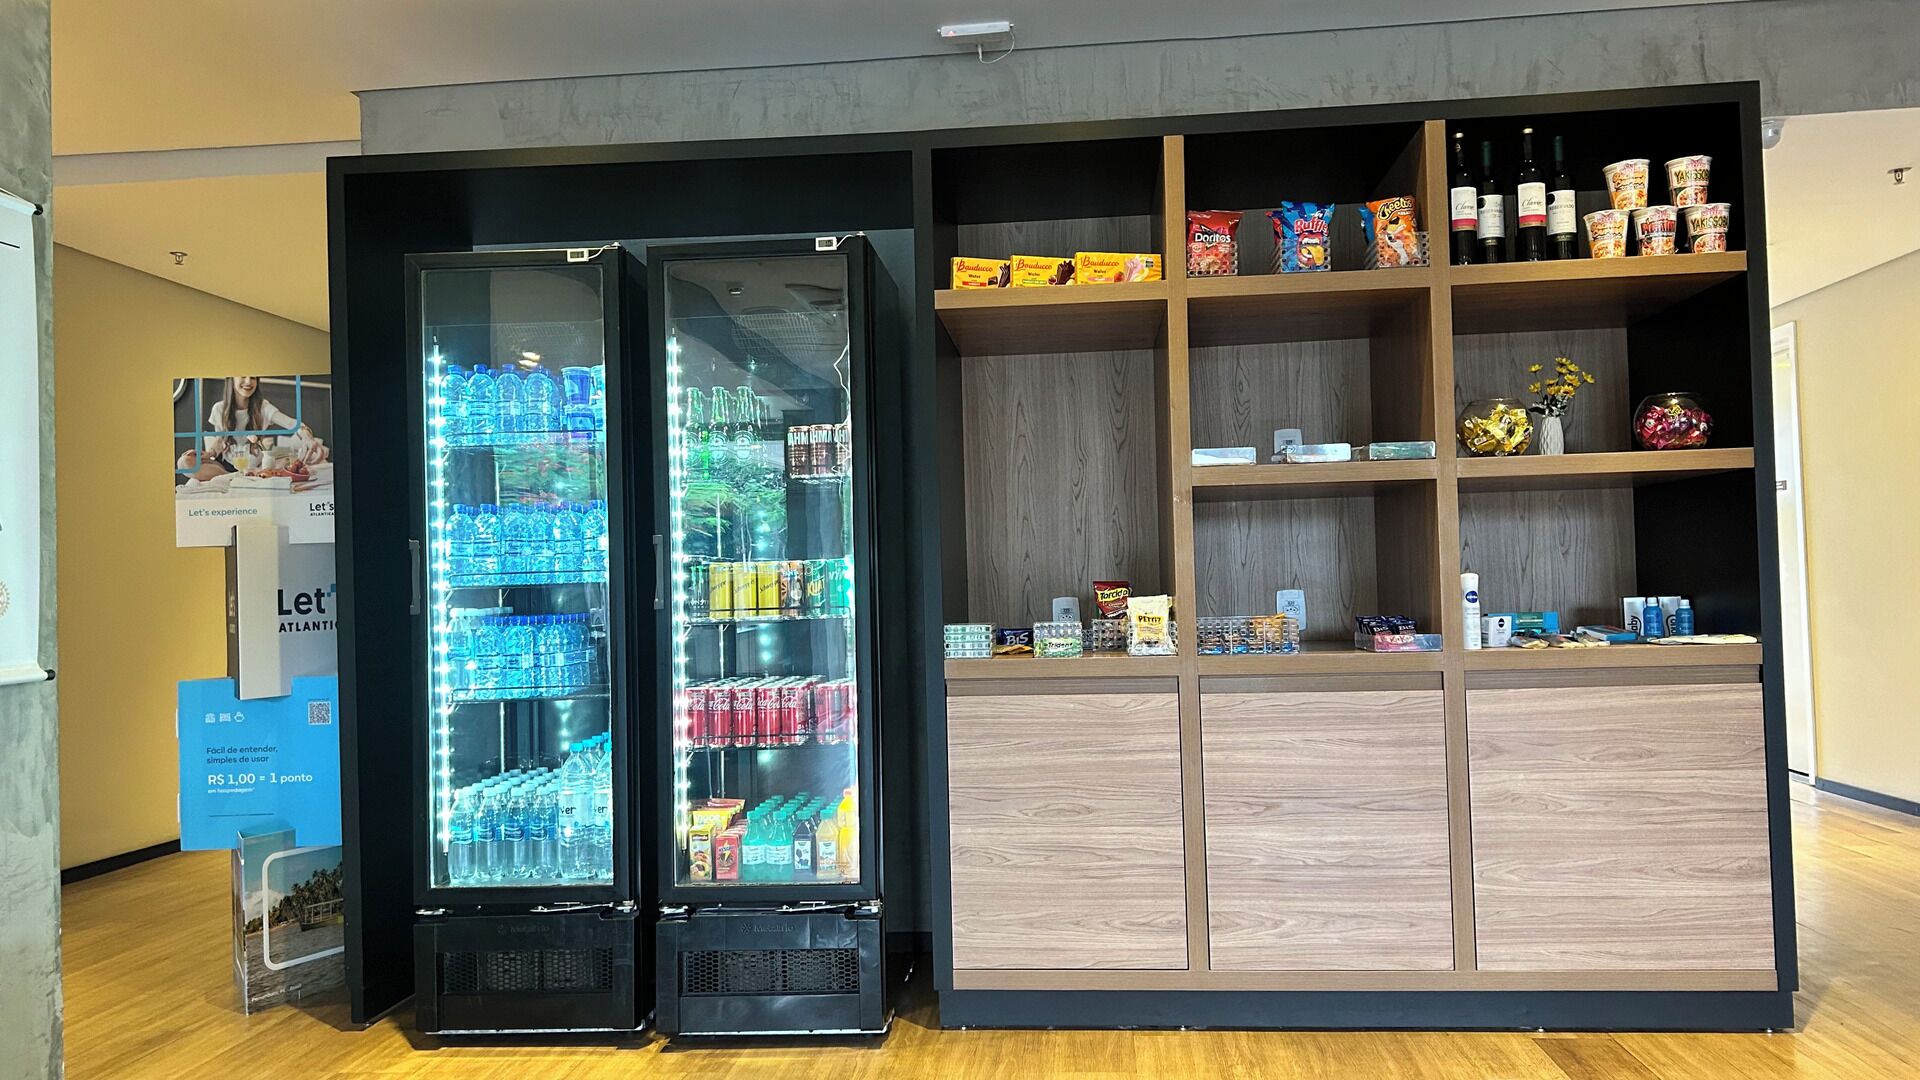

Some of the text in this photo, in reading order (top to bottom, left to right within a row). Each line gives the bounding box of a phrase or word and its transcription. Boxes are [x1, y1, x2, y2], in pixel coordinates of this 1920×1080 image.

[1379, 198, 1413, 220] Cheetos
[1195, 232, 1231, 243] Doritos
[957, 260, 993, 272] Bauducco
[1016, 259, 1053, 271] Bauducco
[1081, 256, 1120, 268] Bauducco
[310, 501, 334, 511] Let's
[188, 507, 258, 517] Let's experience
[1100, 589, 1128, 600] Torcida
[1048, 641, 1073, 649] Trident
[206, 756, 237, 765] simples
[208, 773, 225, 786] R$
[228, 773, 256, 786] 1,00
[270, 772, 278, 783] 1
[280, 773, 313, 784] ponto
